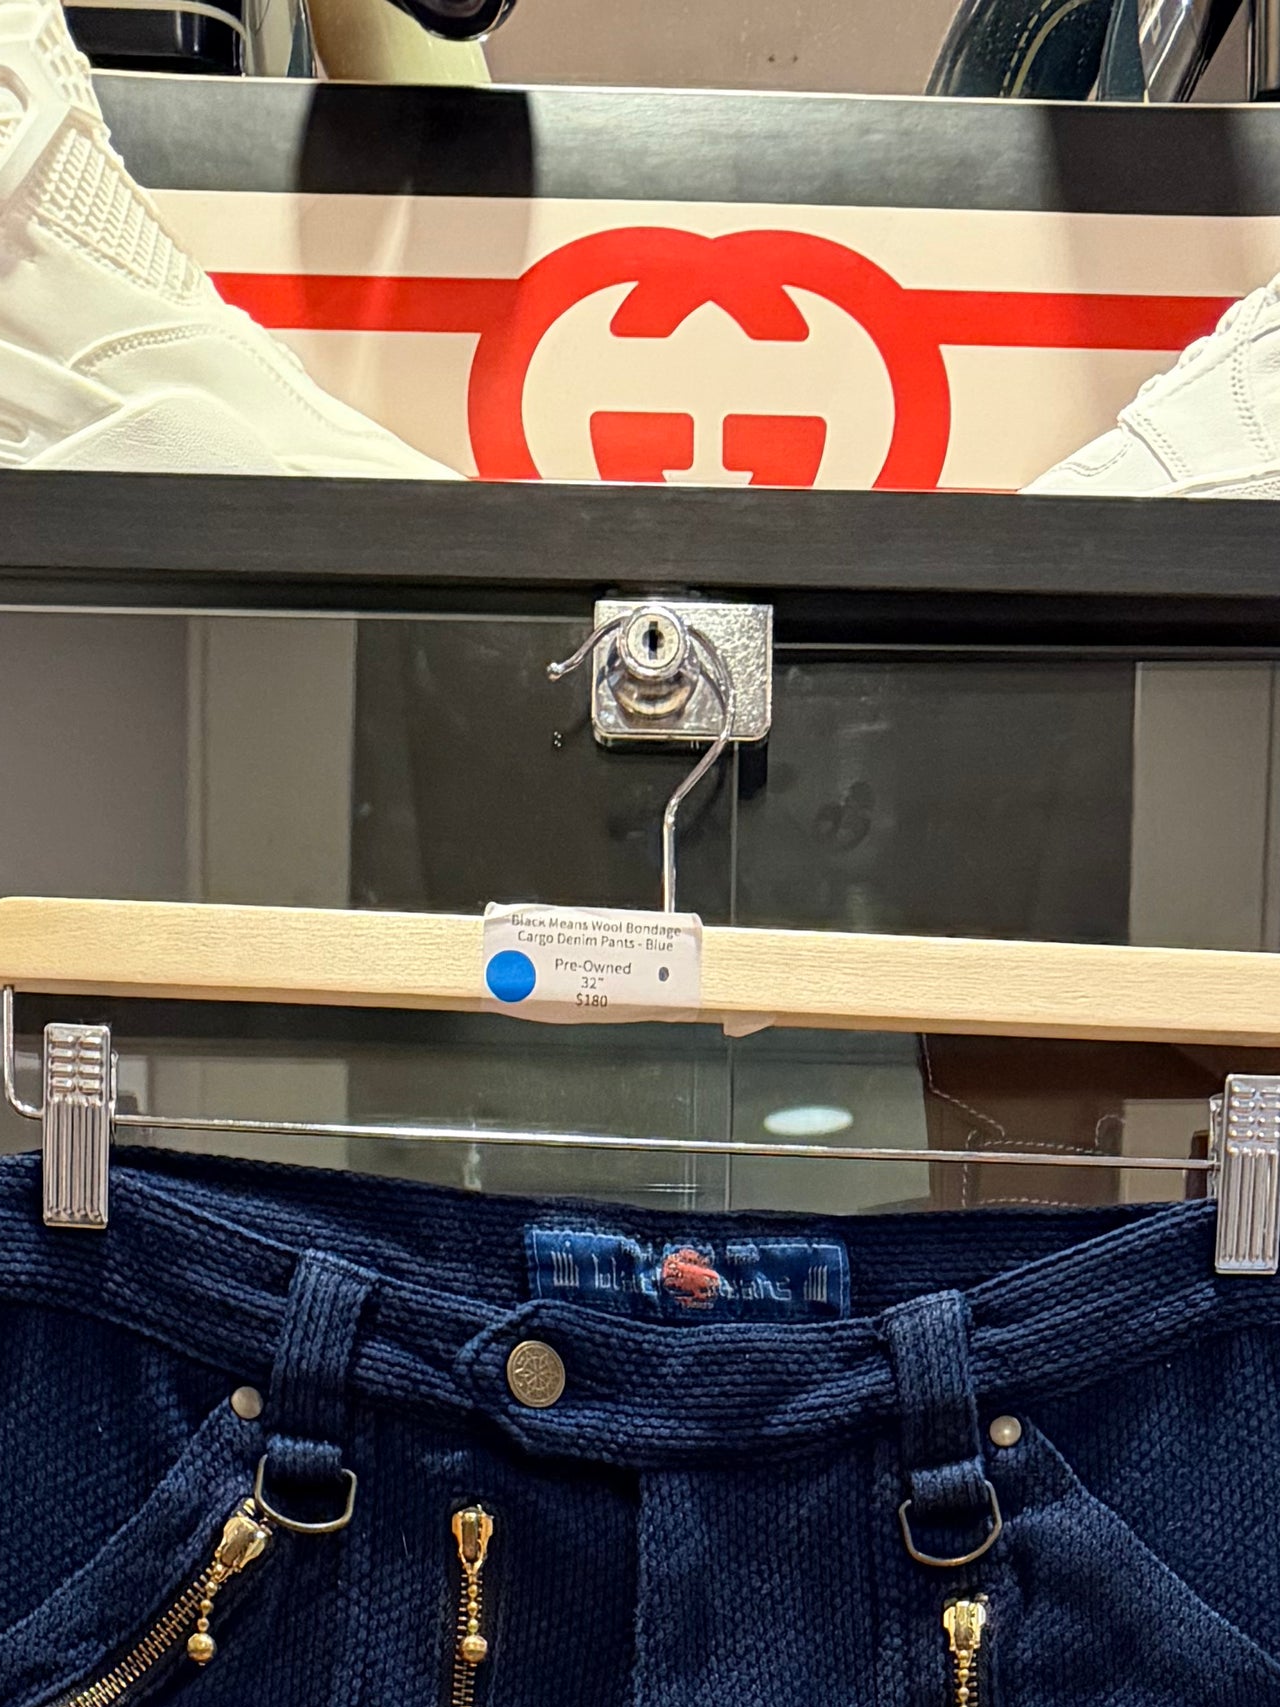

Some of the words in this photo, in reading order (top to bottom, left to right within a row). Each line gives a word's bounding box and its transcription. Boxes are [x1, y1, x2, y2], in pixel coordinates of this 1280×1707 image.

[511, 913, 547, 929] Black
[548, 916, 588, 932] Means
[591, 918, 623, 933] Wool
[625, 922, 682, 939] Bondage
[517, 930, 554, 947] Cargo
[557, 933, 598, 948] Denim
[601, 935, 635, 950] Pants
[645, 939, 674, 952] Blue
[554, 958, 632, 975] Pre-Owned
[575, 993, 609, 1008] $180
